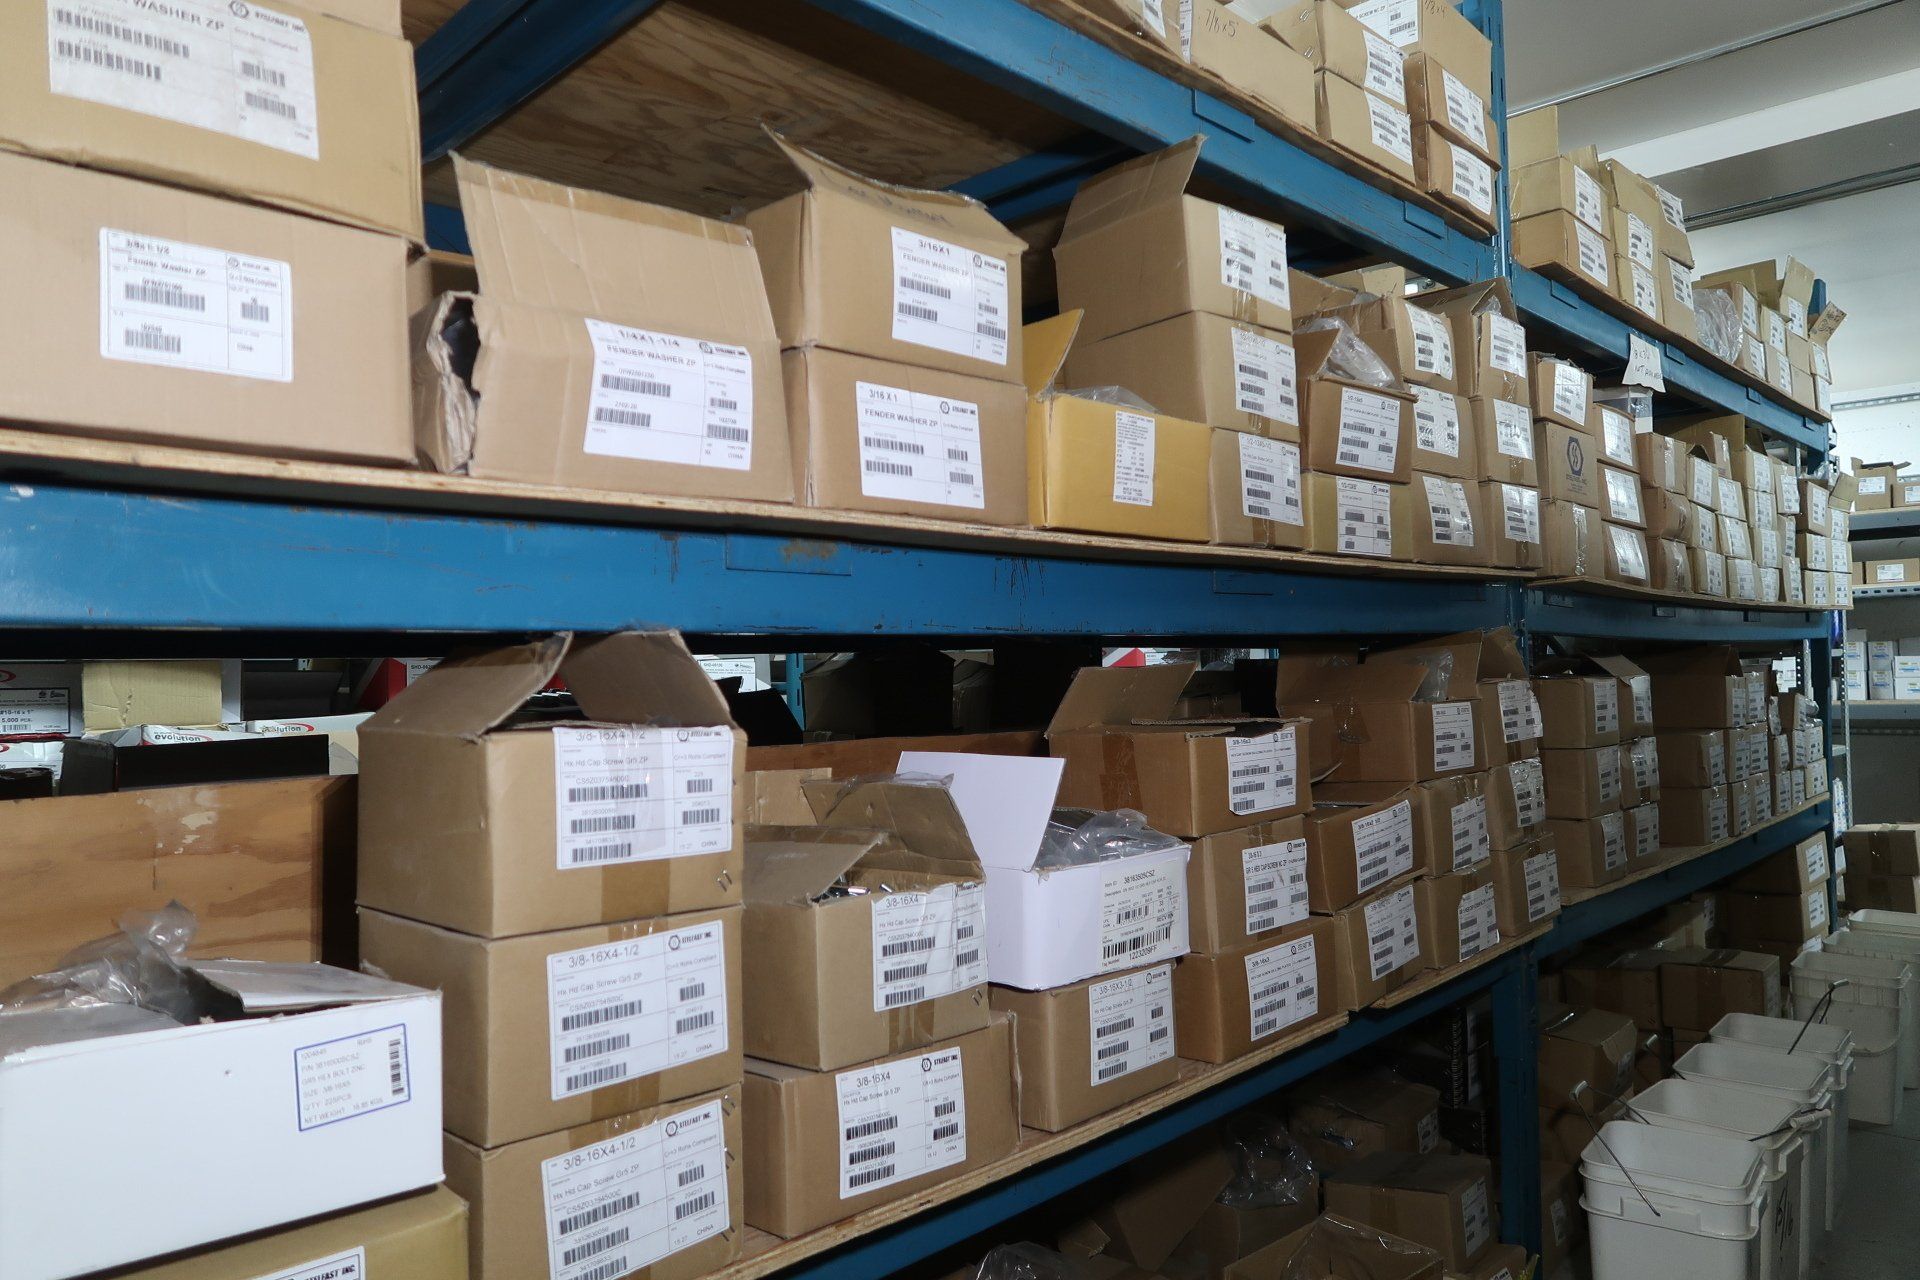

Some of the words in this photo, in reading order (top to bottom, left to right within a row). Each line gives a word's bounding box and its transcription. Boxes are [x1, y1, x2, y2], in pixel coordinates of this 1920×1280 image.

[134, 0, 201, 25] WASHER
[206, 17, 225, 31] ZP
[918, 239, 950, 256] 3/16X1
[902, 252, 930, 267] FENDER
[932, 260, 959, 274] WASHER
[606, 344, 644, 358] FENDER
[646, 350, 684, 365] WASHER
[686, 357, 696, 367] ZP
[865, 408, 895, 420] FENDER
[896, 413, 928, 427] WASHER
[929, 419, 938, 427] ZP
[154, 734, 201, 743] evolution
[576, 759, 586, 767] Hd
[587, 759, 601, 768] Cap
[602, 757, 624, 766] Screw
[639, 756, 649, 764] ZP
[885, 895, 919, 909] 3/8-16X4
[895, 919, 904, 928] Cap
[568, 944, 640, 968] 3/8-16X4-1/2
[568, 986, 579, 995] Hd
[580, 984, 594, 994] Cap
[596, 977, 618, 988] Screw
[633, 972, 642, 981] ZP
[856, 1071, 892, 1089] 3/8-16X4
[858, 1096, 868, 1104] Cap
[869, 1091, 884, 1100] Screw
[679, 1116, 701, 1129] STELFAST
[563, 1136, 636, 1171] 3/8-16X4-1/2
[552, 1192, 564, 1201] Hx
[564, 1188, 576, 1198] Hd
[576, 1182, 592, 1194] Cap
[594, 1176, 615, 1188] Screw
[630, 1163, 640, 1173] ZP
[696, 1224, 714, 1236] CHINA
